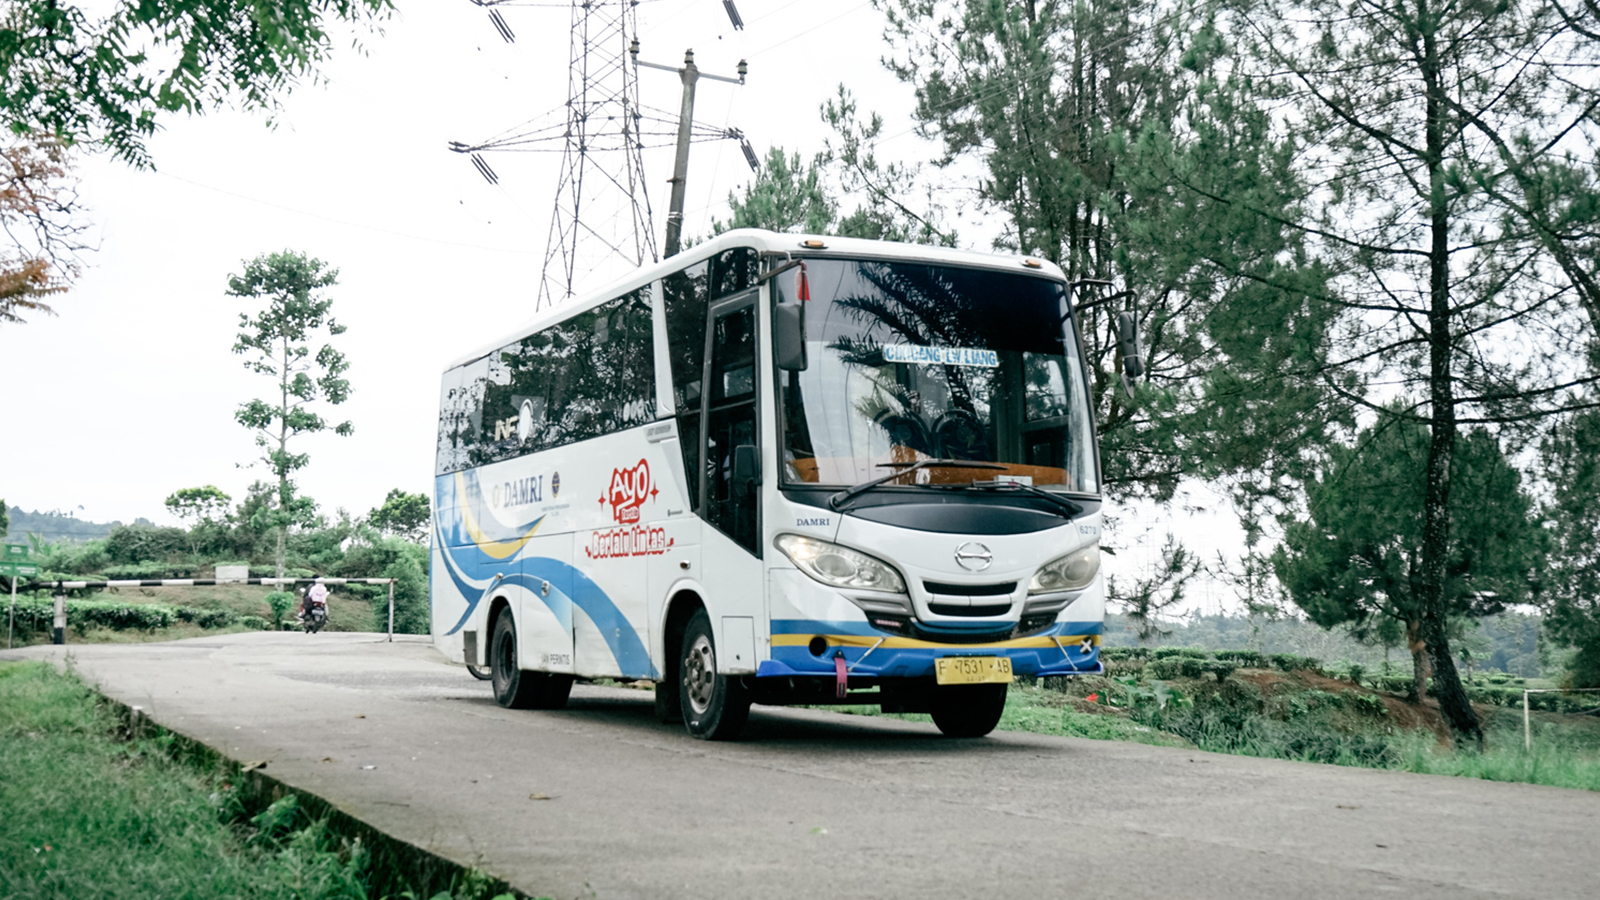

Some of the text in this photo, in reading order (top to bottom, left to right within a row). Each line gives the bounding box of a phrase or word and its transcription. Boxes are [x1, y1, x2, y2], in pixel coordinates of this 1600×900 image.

[503, 475, 543, 508] DAMRI
[796, 518, 830, 526] DAMRI
[592, 526, 665, 558] Berlalu Lintas
[938, 659, 1010, 675] F 7531 AB
